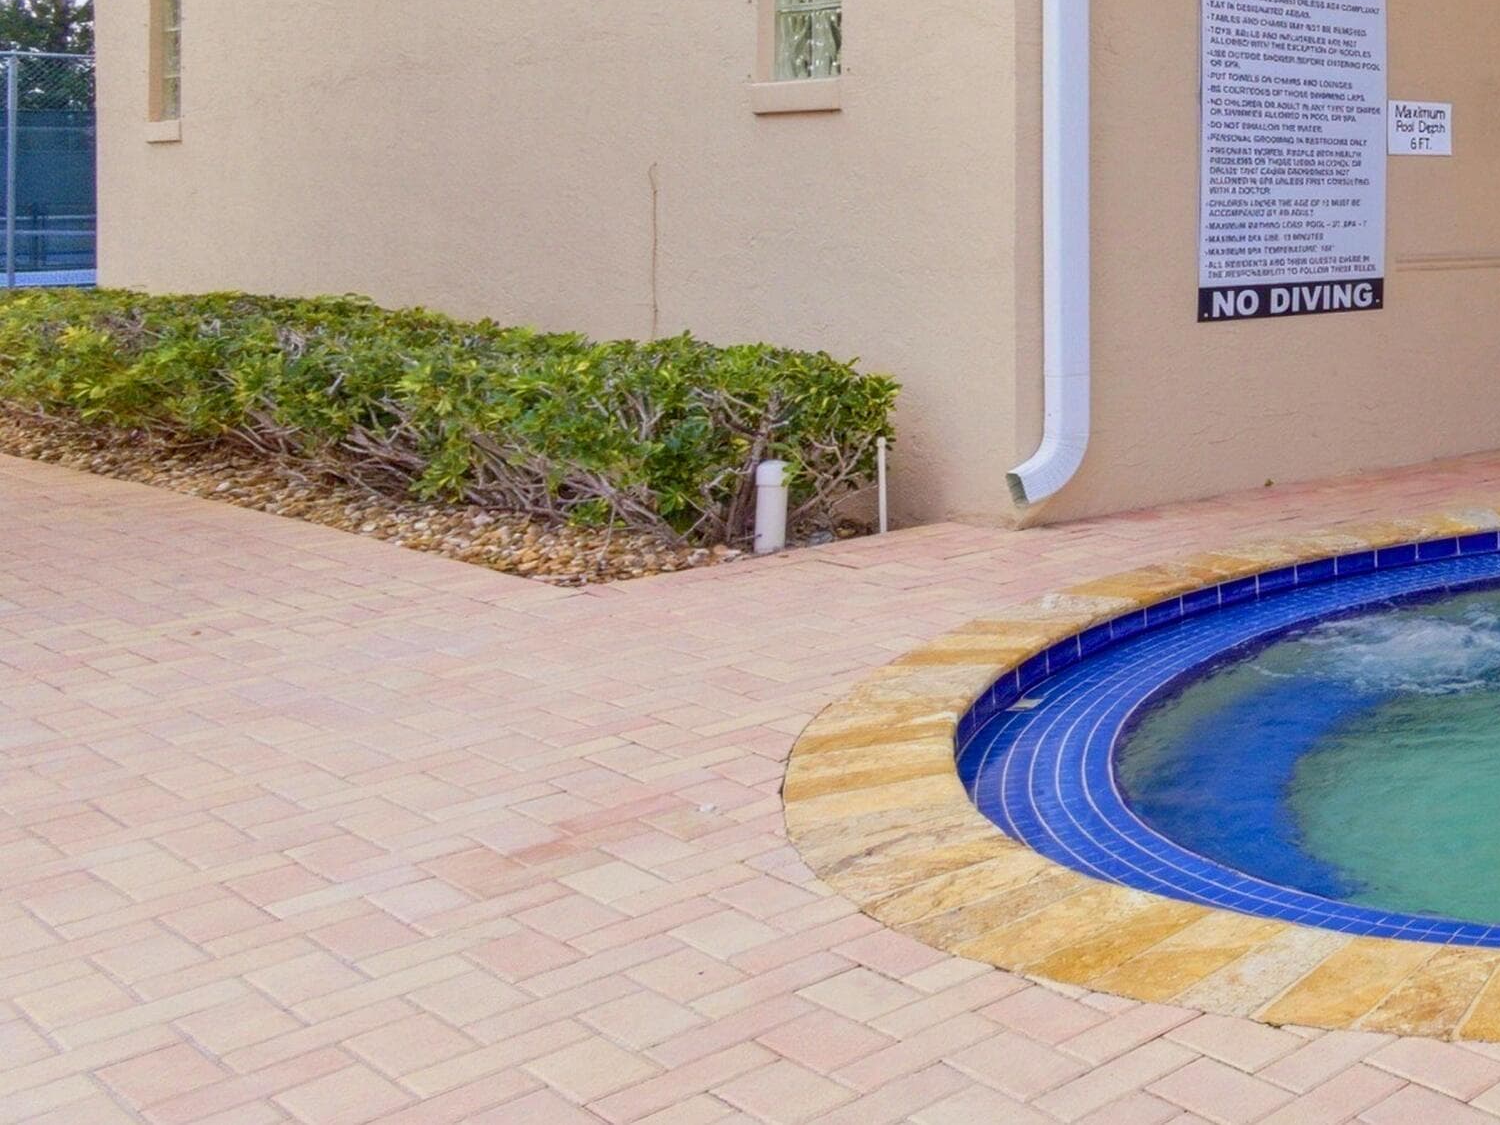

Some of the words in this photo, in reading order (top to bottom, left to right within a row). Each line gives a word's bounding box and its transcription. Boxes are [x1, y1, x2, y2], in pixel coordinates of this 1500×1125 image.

[1395, 105, 1446, 120] Maximum
[1396, 120, 1414, 132] Pool
[1418, 120, 1446, 137] Depth
[1410, 138, 1417, 150] 6
[1212, 289, 1259, 318] NO
[1270, 282, 1373, 313] DIVING
